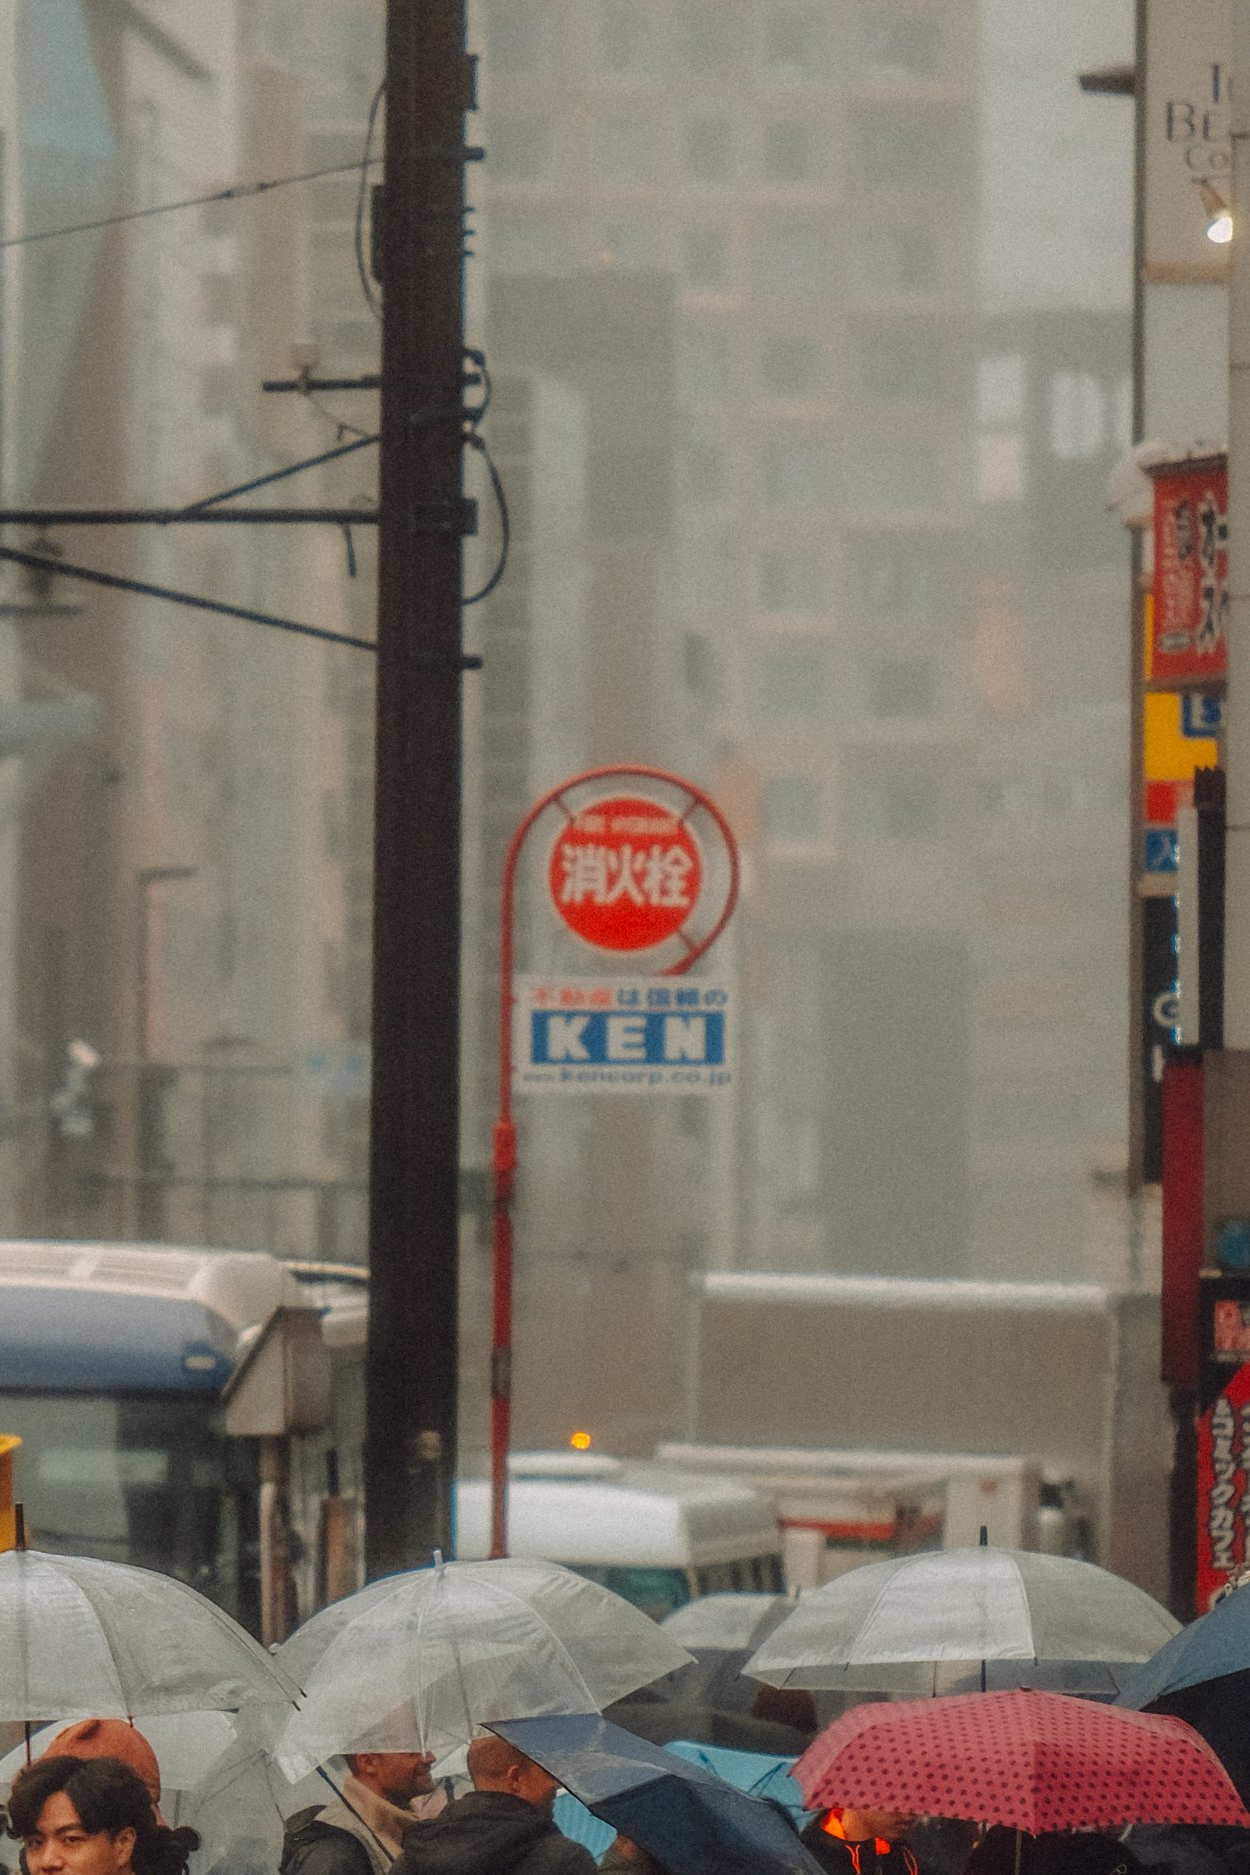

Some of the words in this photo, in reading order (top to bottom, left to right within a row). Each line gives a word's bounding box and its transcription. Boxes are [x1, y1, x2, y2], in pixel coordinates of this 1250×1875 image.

[560, 844, 693, 905] 消火栓
[547, 1016, 706, 1061] KEN
